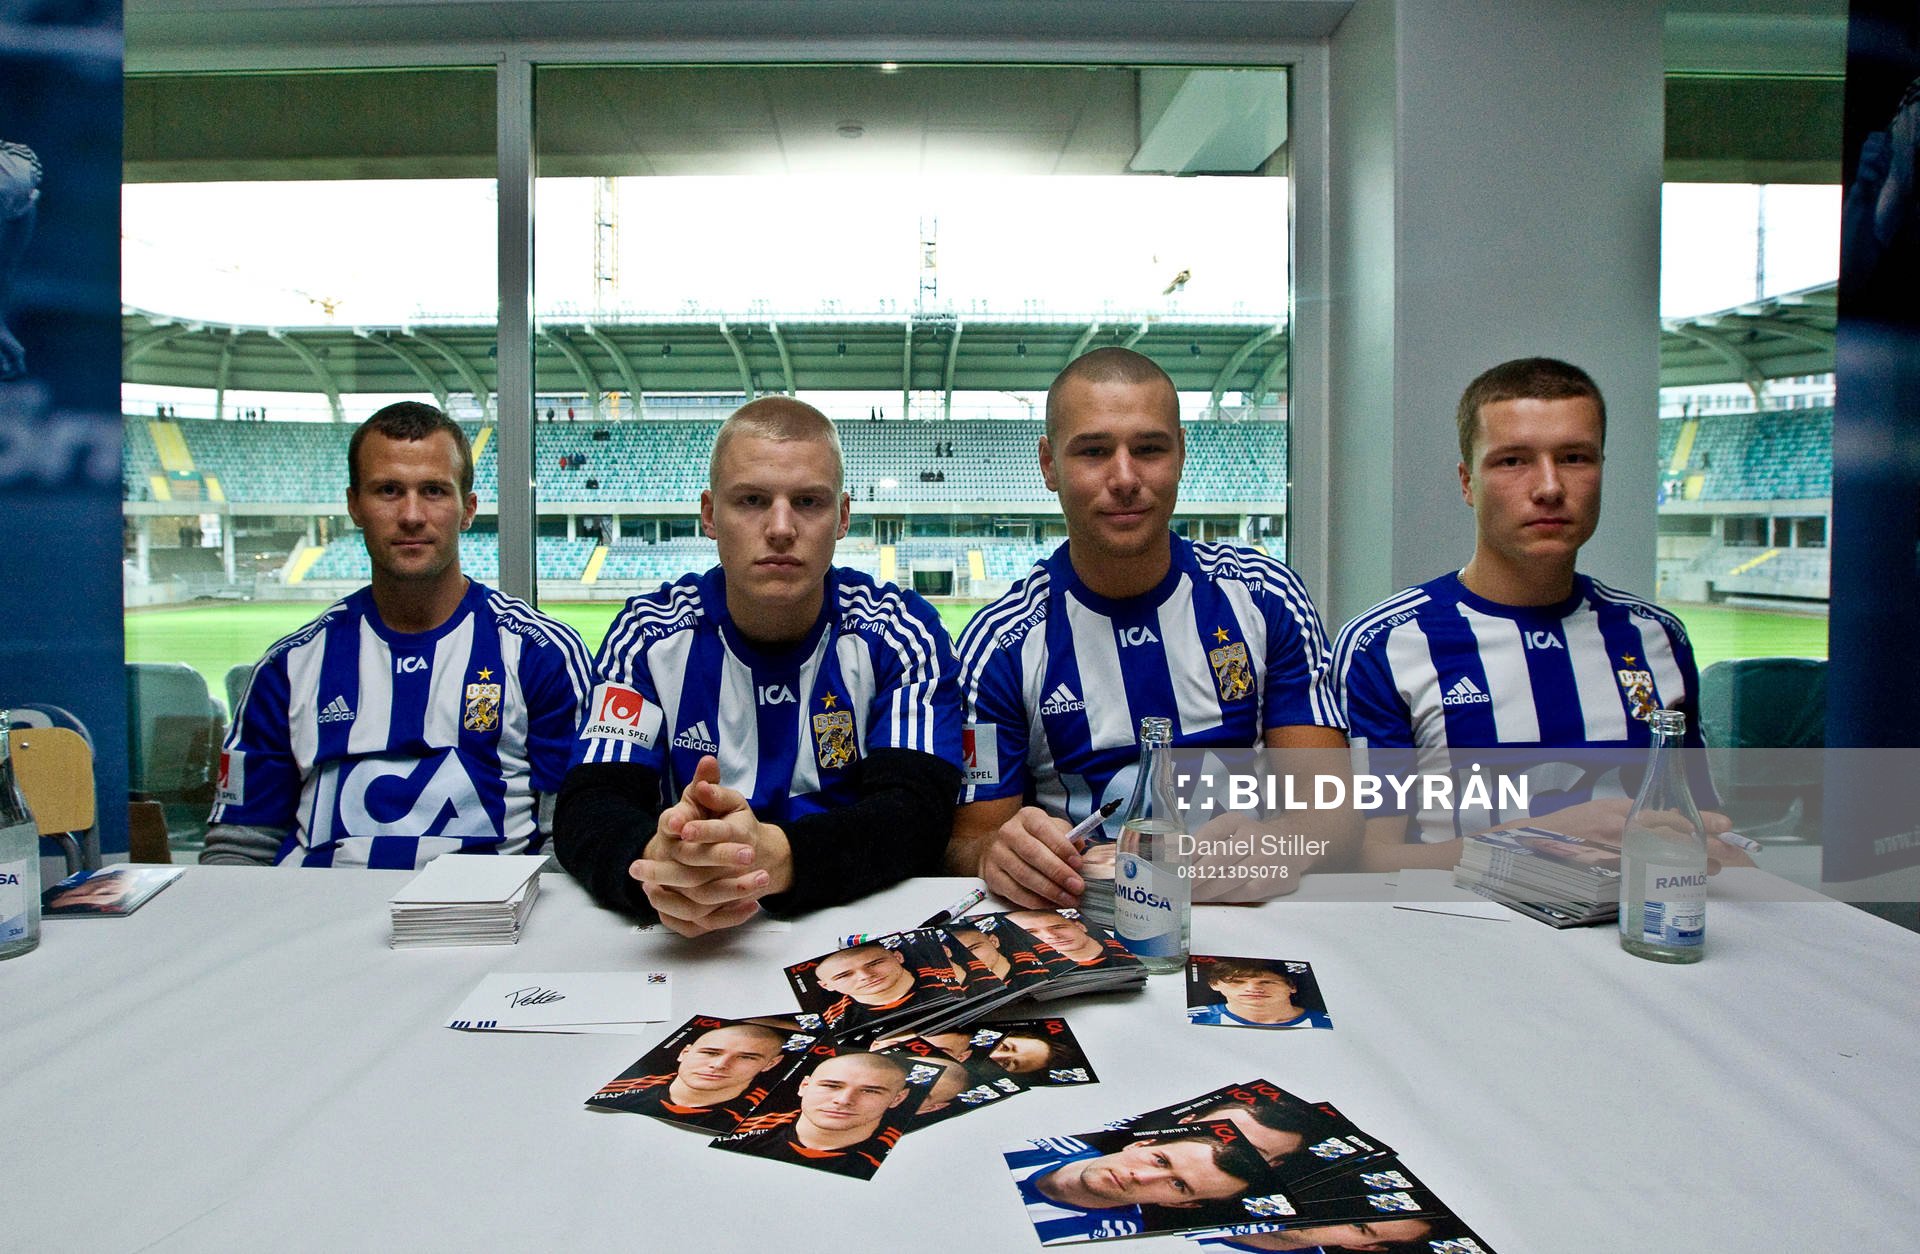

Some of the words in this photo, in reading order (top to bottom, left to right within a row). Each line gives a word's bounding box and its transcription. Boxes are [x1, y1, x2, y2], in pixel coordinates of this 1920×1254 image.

[1118, 626, 1159, 648] ICA
[1524, 631, 1564, 650] ICA
[396, 656, 428, 674] ICA
[758, 684, 796, 706] ICA
[1443, 693, 1490, 705] adidas
[1041, 700, 1086, 715] adidas
[318, 710, 356, 724] adidas
[628, 729, 650, 743] SPEL
[673, 737, 717, 753] adidas
[970, 771, 993, 780] SPEL
[310, 748, 500, 849] ICA
[790, 962, 818, 975] ICA
[693, 1018, 721, 1030] ICA
[1044, 1020, 1066, 1036] ICA
[906, 1040, 932, 1057] ICA
[1226, 1088, 1257, 1106] ICA
[1251, 1082, 1282, 1102] ICA
[1208, 1123, 1239, 1146] ICA
